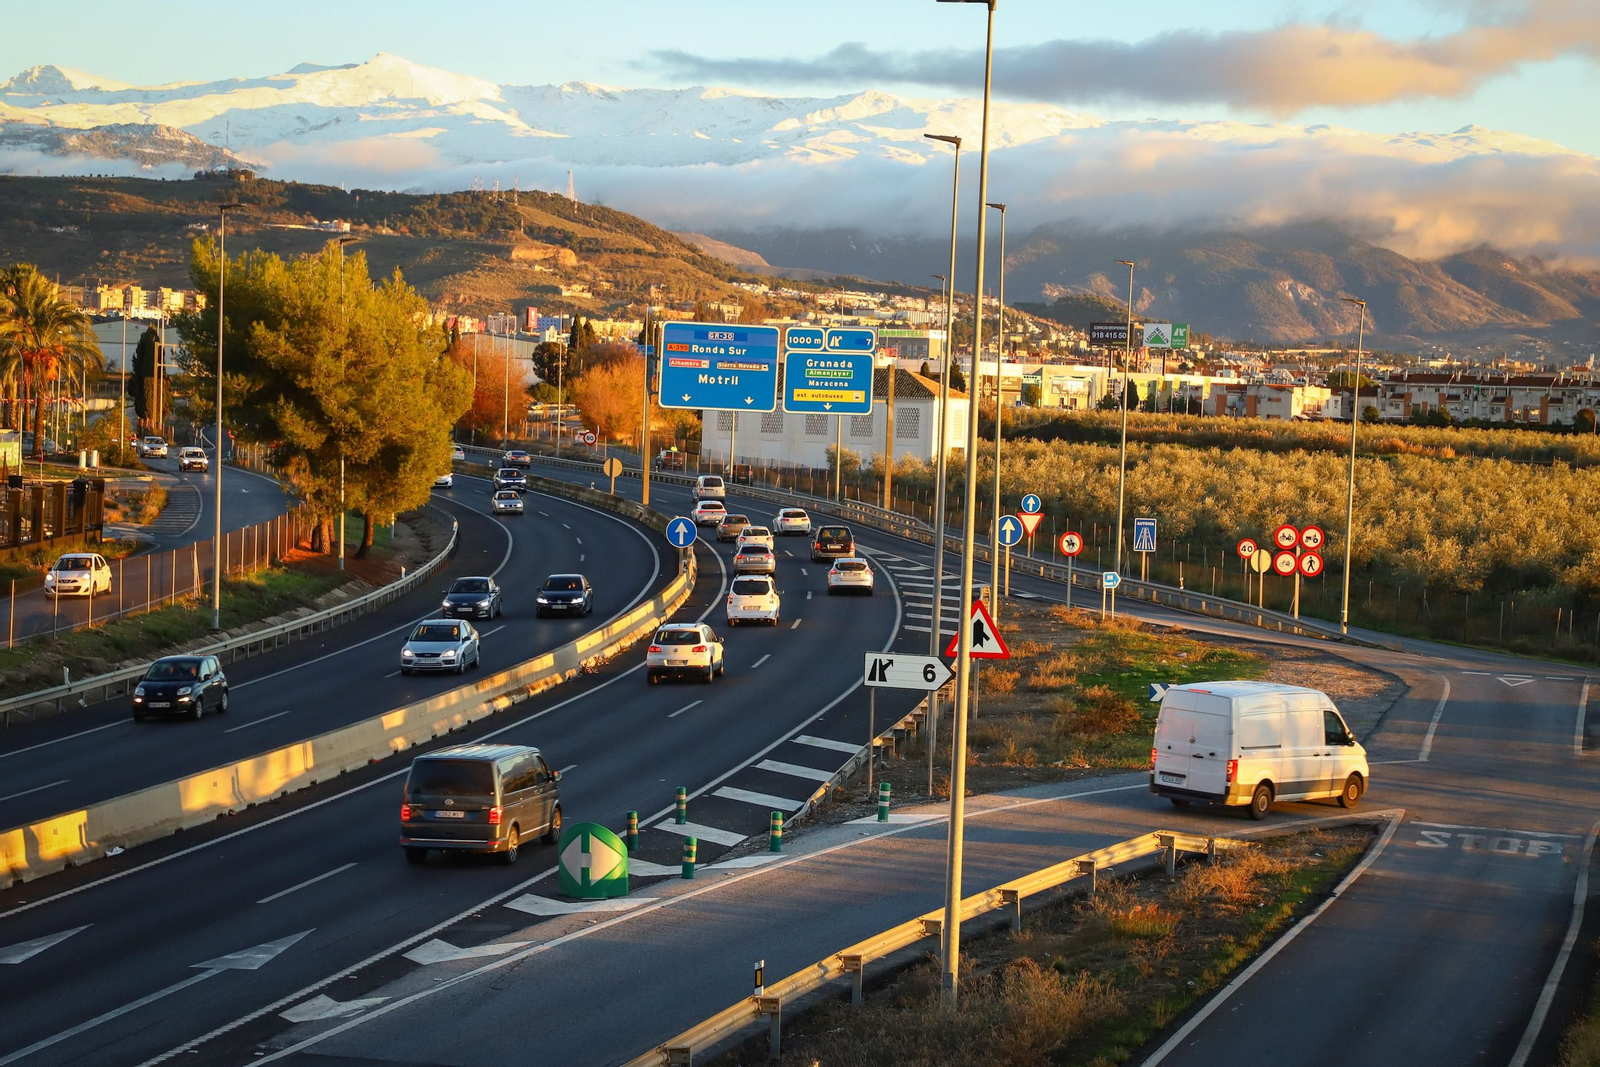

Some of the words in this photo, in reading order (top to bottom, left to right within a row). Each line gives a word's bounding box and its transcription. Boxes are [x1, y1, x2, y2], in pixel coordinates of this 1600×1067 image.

[709, 332, 734, 340] GR-30
[1092, 331, 1104, 339] 918
[788, 336, 812, 344] 1000
[865, 338, 872, 346] 7
[692, 344, 725, 355] Ronda
[728, 346, 747, 355] Sur
[806, 359, 853, 368] Granada
[698, 374, 739, 385] Motril
[1241, 545, 1253, 553] 40
[922, 663, 936, 683] 6
[1415, 830, 1564, 857] STOP
